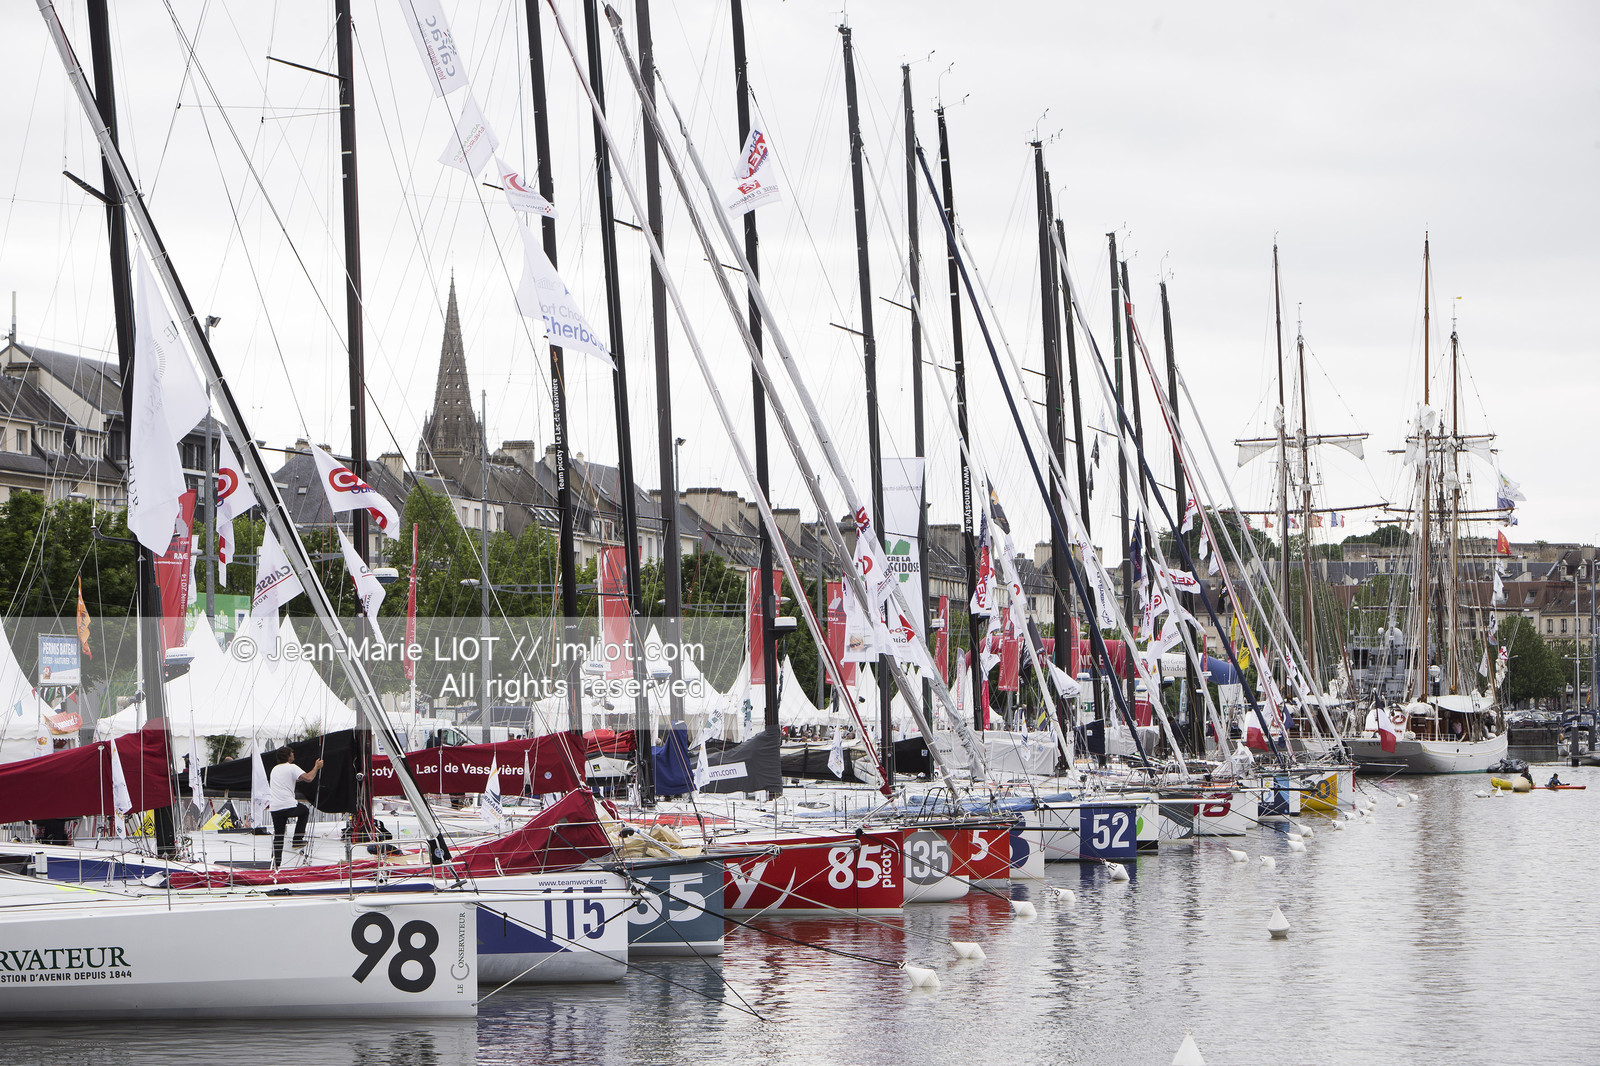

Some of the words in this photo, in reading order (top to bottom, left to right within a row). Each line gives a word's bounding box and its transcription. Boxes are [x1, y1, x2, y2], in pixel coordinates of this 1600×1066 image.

[963, 465, 974, 533] www.renostyle.fr
[444, 762, 459, 774] de
[1092, 811, 1130, 850] 52
[828, 845, 883, 890] 85
[878, 846, 896, 888] picoty
[904, 840, 949, 878] 135
[538, 878, 608, 888] www.teamwork.net
[542, 886, 606, 940] 115
[351, 911, 440, 994] 98
[451, 911, 470, 981] CONSERVATEUR
[30, 972, 71, 982] D'AVENIR
[74, 970, 107, 980] DEPUIS
[109, 970, 132, 979] 1844
[457, 983, 464, 994] LE
